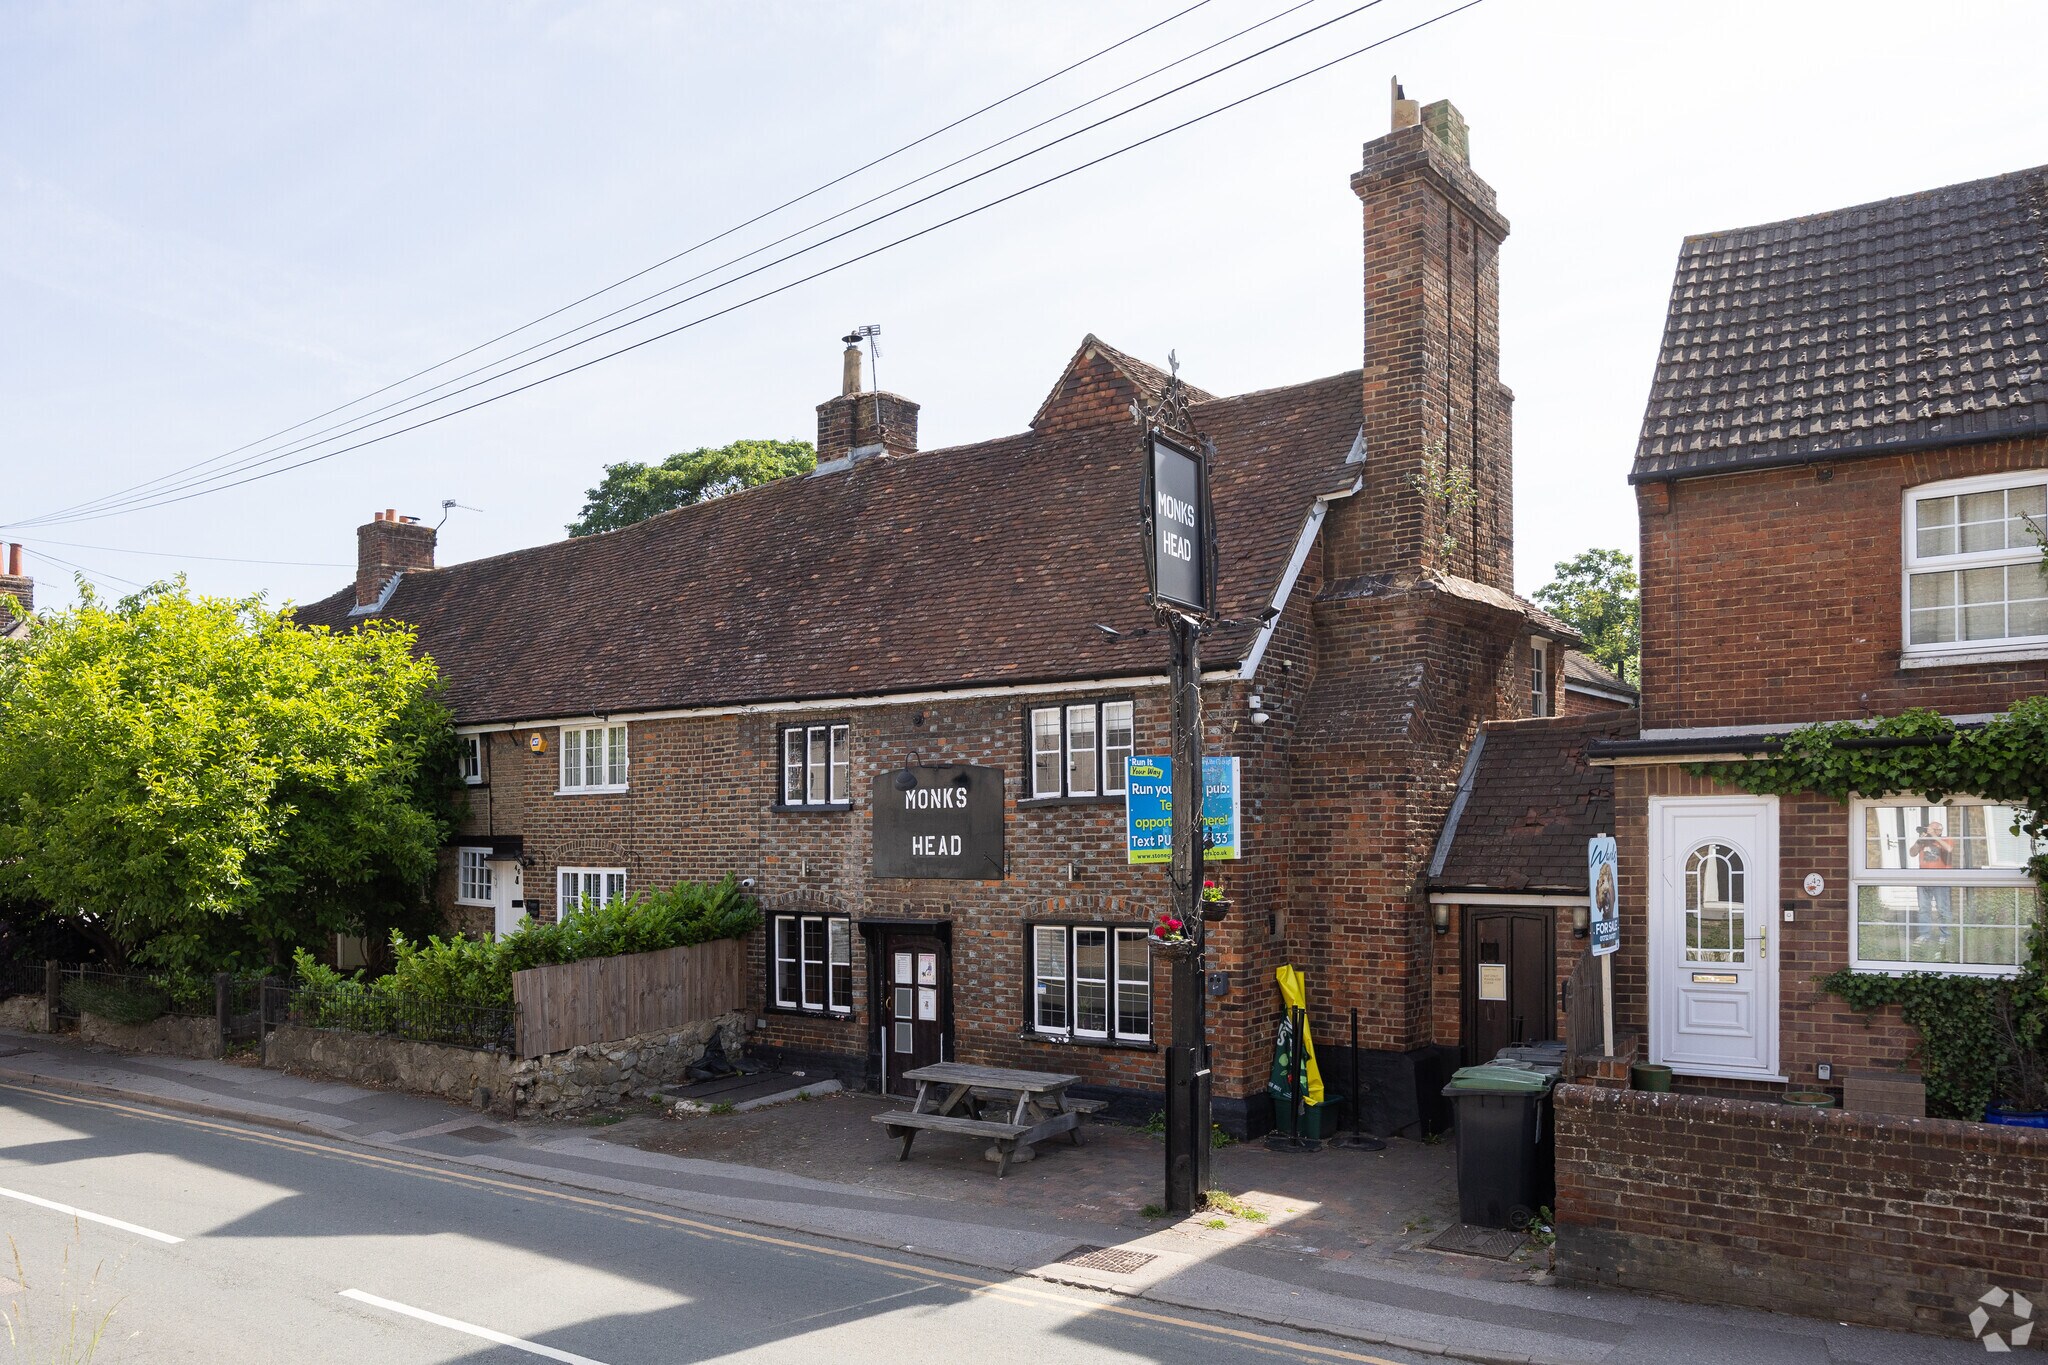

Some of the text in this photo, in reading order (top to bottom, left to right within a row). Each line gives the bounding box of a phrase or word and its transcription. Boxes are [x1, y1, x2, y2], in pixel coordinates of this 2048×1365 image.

[1158, 491, 1194, 528] MONKS
[1163, 530, 1191, 562] HEAD
[1131, 758, 1145, 766] Run
[1132, 767, 1161, 778] Your Way
[1131, 782, 1230, 798] Run you pub:
[905, 787, 968, 810] MONKS
[1135, 817, 1172, 831] opport
[912, 835, 962, 856] HEAD
[1131, 835, 1156, 847] Text
[1157, 834, 1172, 846] PU
[1595, 920, 1618, 935] FOR SALE
